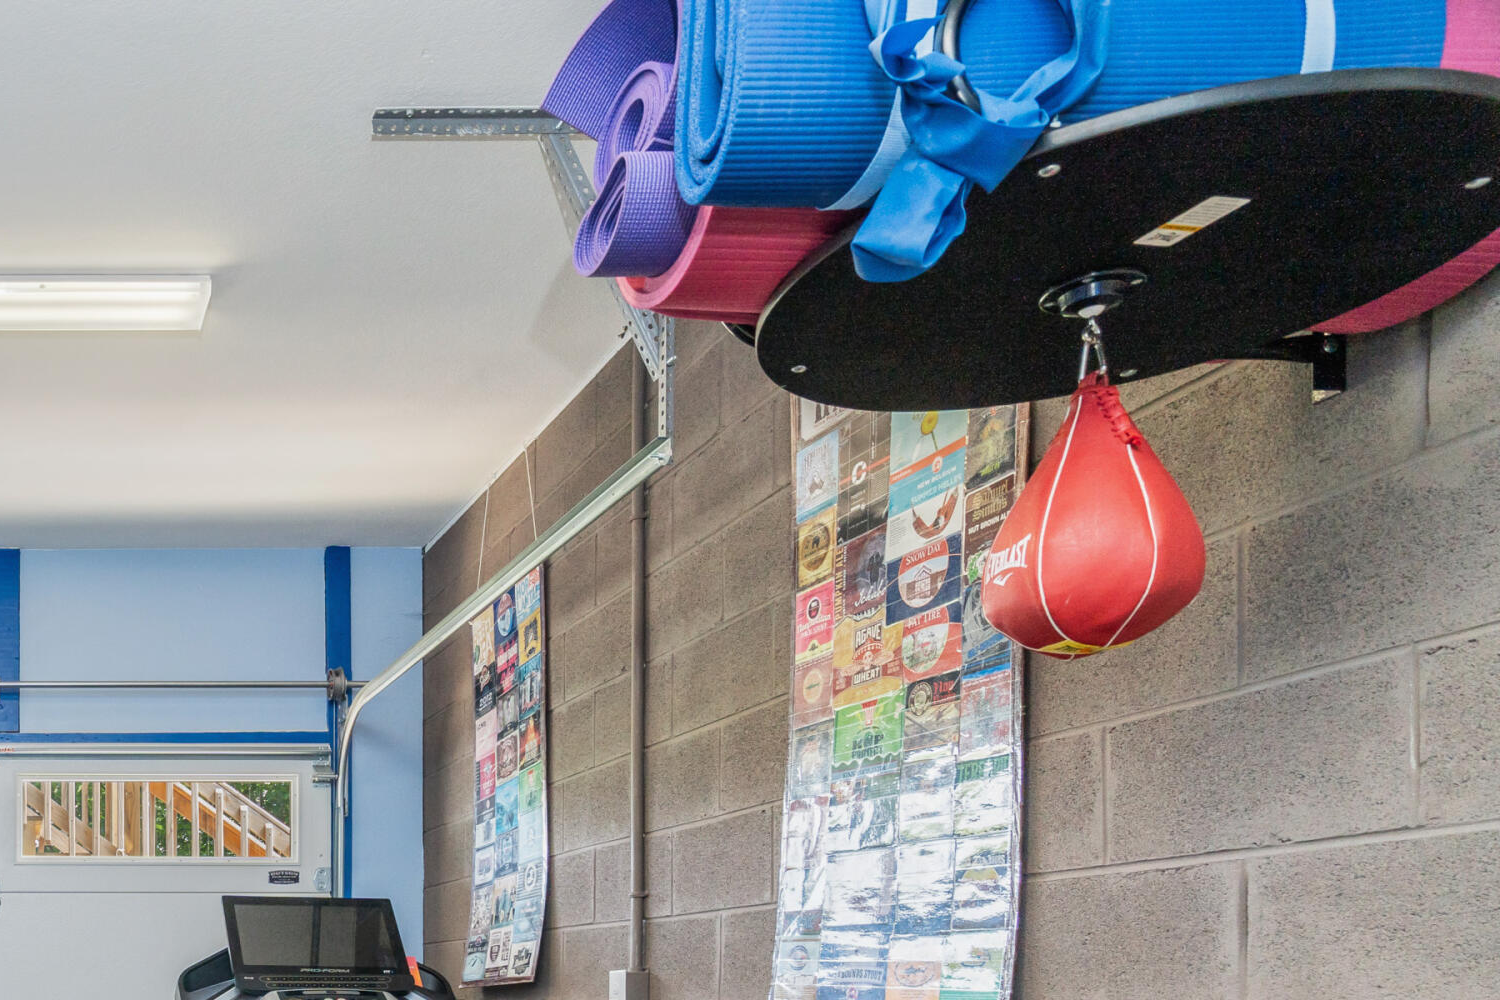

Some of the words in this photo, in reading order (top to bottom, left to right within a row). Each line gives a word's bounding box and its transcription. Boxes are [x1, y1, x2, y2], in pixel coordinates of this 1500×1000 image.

[905, 551, 926, 566] SNOW
[927, 541, 942, 556] DAY
[984, 533, 1032, 585] EVERLAST
[923, 608, 941, 623] TIRE
[855, 622, 882, 648] AGAVE
[853, 666, 880, 684] WHEAT
